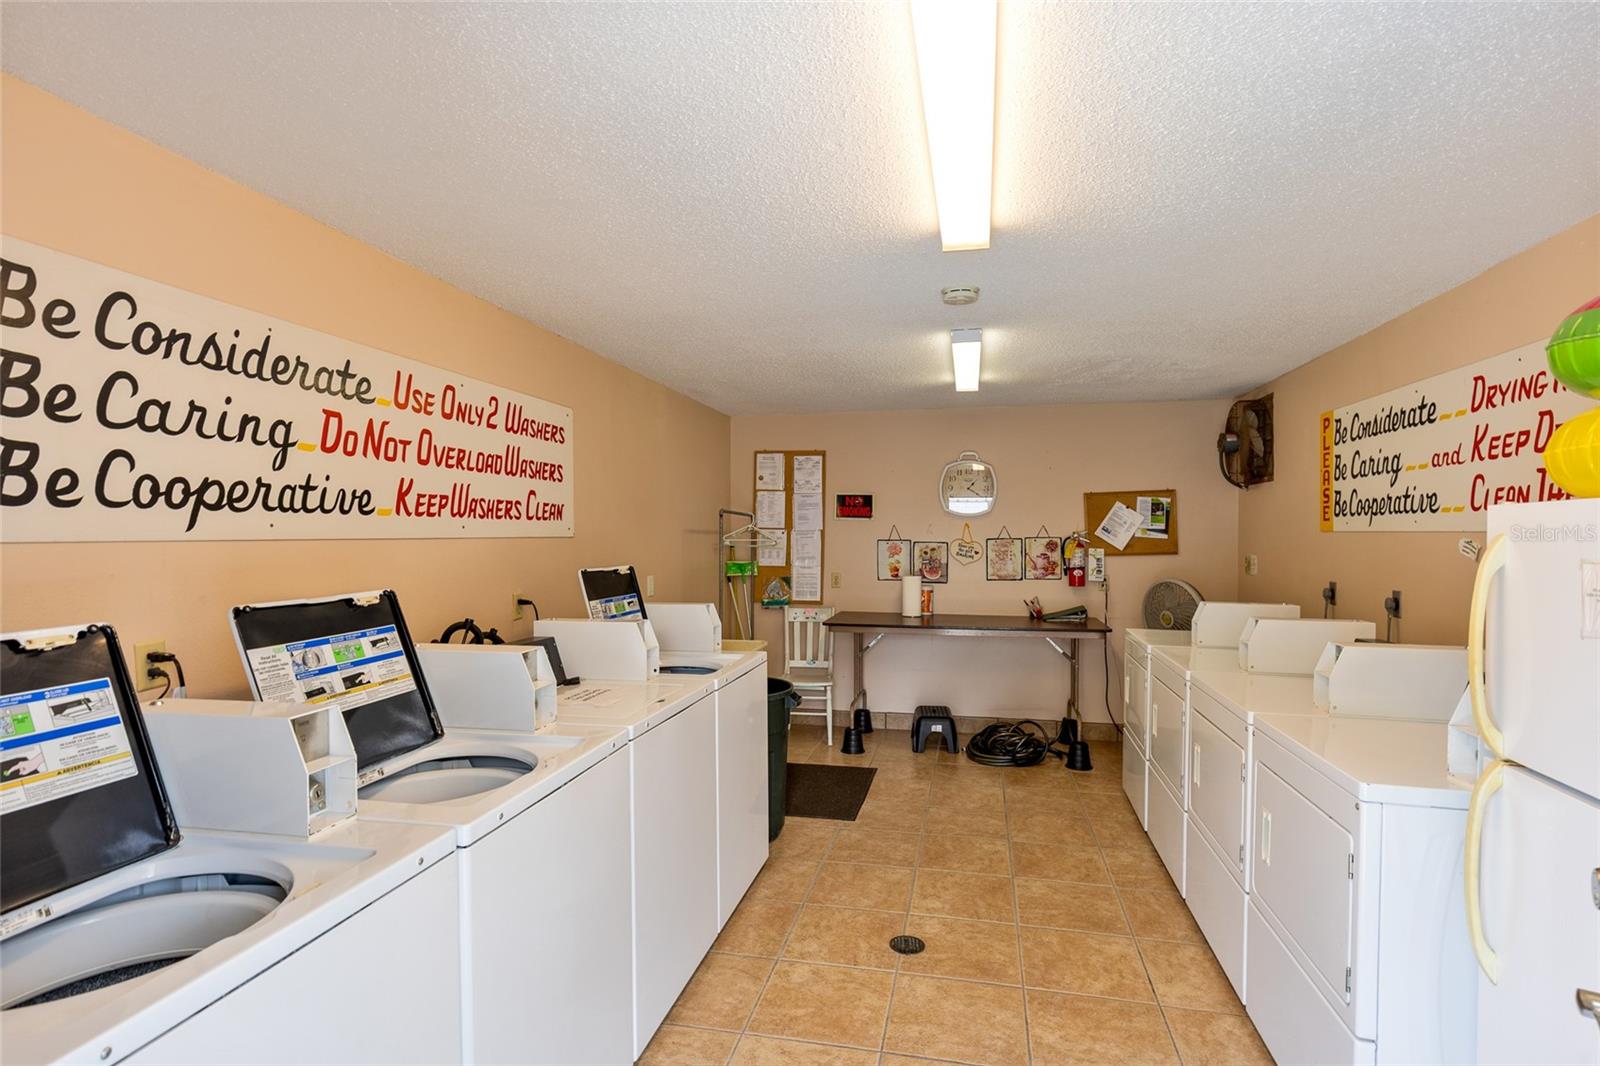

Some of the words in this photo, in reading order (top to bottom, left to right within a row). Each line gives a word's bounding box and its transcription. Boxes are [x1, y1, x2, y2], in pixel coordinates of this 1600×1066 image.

[0, 257, 81, 339] Be
[94, 291, 376, 405] Considerate
[486, 396, 499, 429] 2
[504, 401, 566, 444] WASHERS
[0, 348, 83, 423] Be
[96, 370, 299, 471] Caring
[362, 417, 412, 463] NOT
[416, 428, 502, 475] OVERLOAD
[504, 444, 564, 483] WASHERS
[1334, 418, 1348, 446] Be
[1350, 395, 1438, 441] Considerate
[1471, 370, 1549, 413] DRYING
[1334, 454, 1347, 481] Be
[1351, 448, 1403, 488] Caring
[1431, 442, 1466, 468] and
[1471, 423, 1531, 462] KEEP
[0, 436, 84, 508] Be
[94, 448, 376, 533] Cooperative
[395, 477, 449, 517] KEEP
[450, 483, 522, 521] WASHERS
[525, 490, 565, 521] CLEAN
[1322, 417, 1331, 522] PLEASE
[1334, 490, 1348, 517] Be
[1349, 485, 1440, 527] Cooperative
